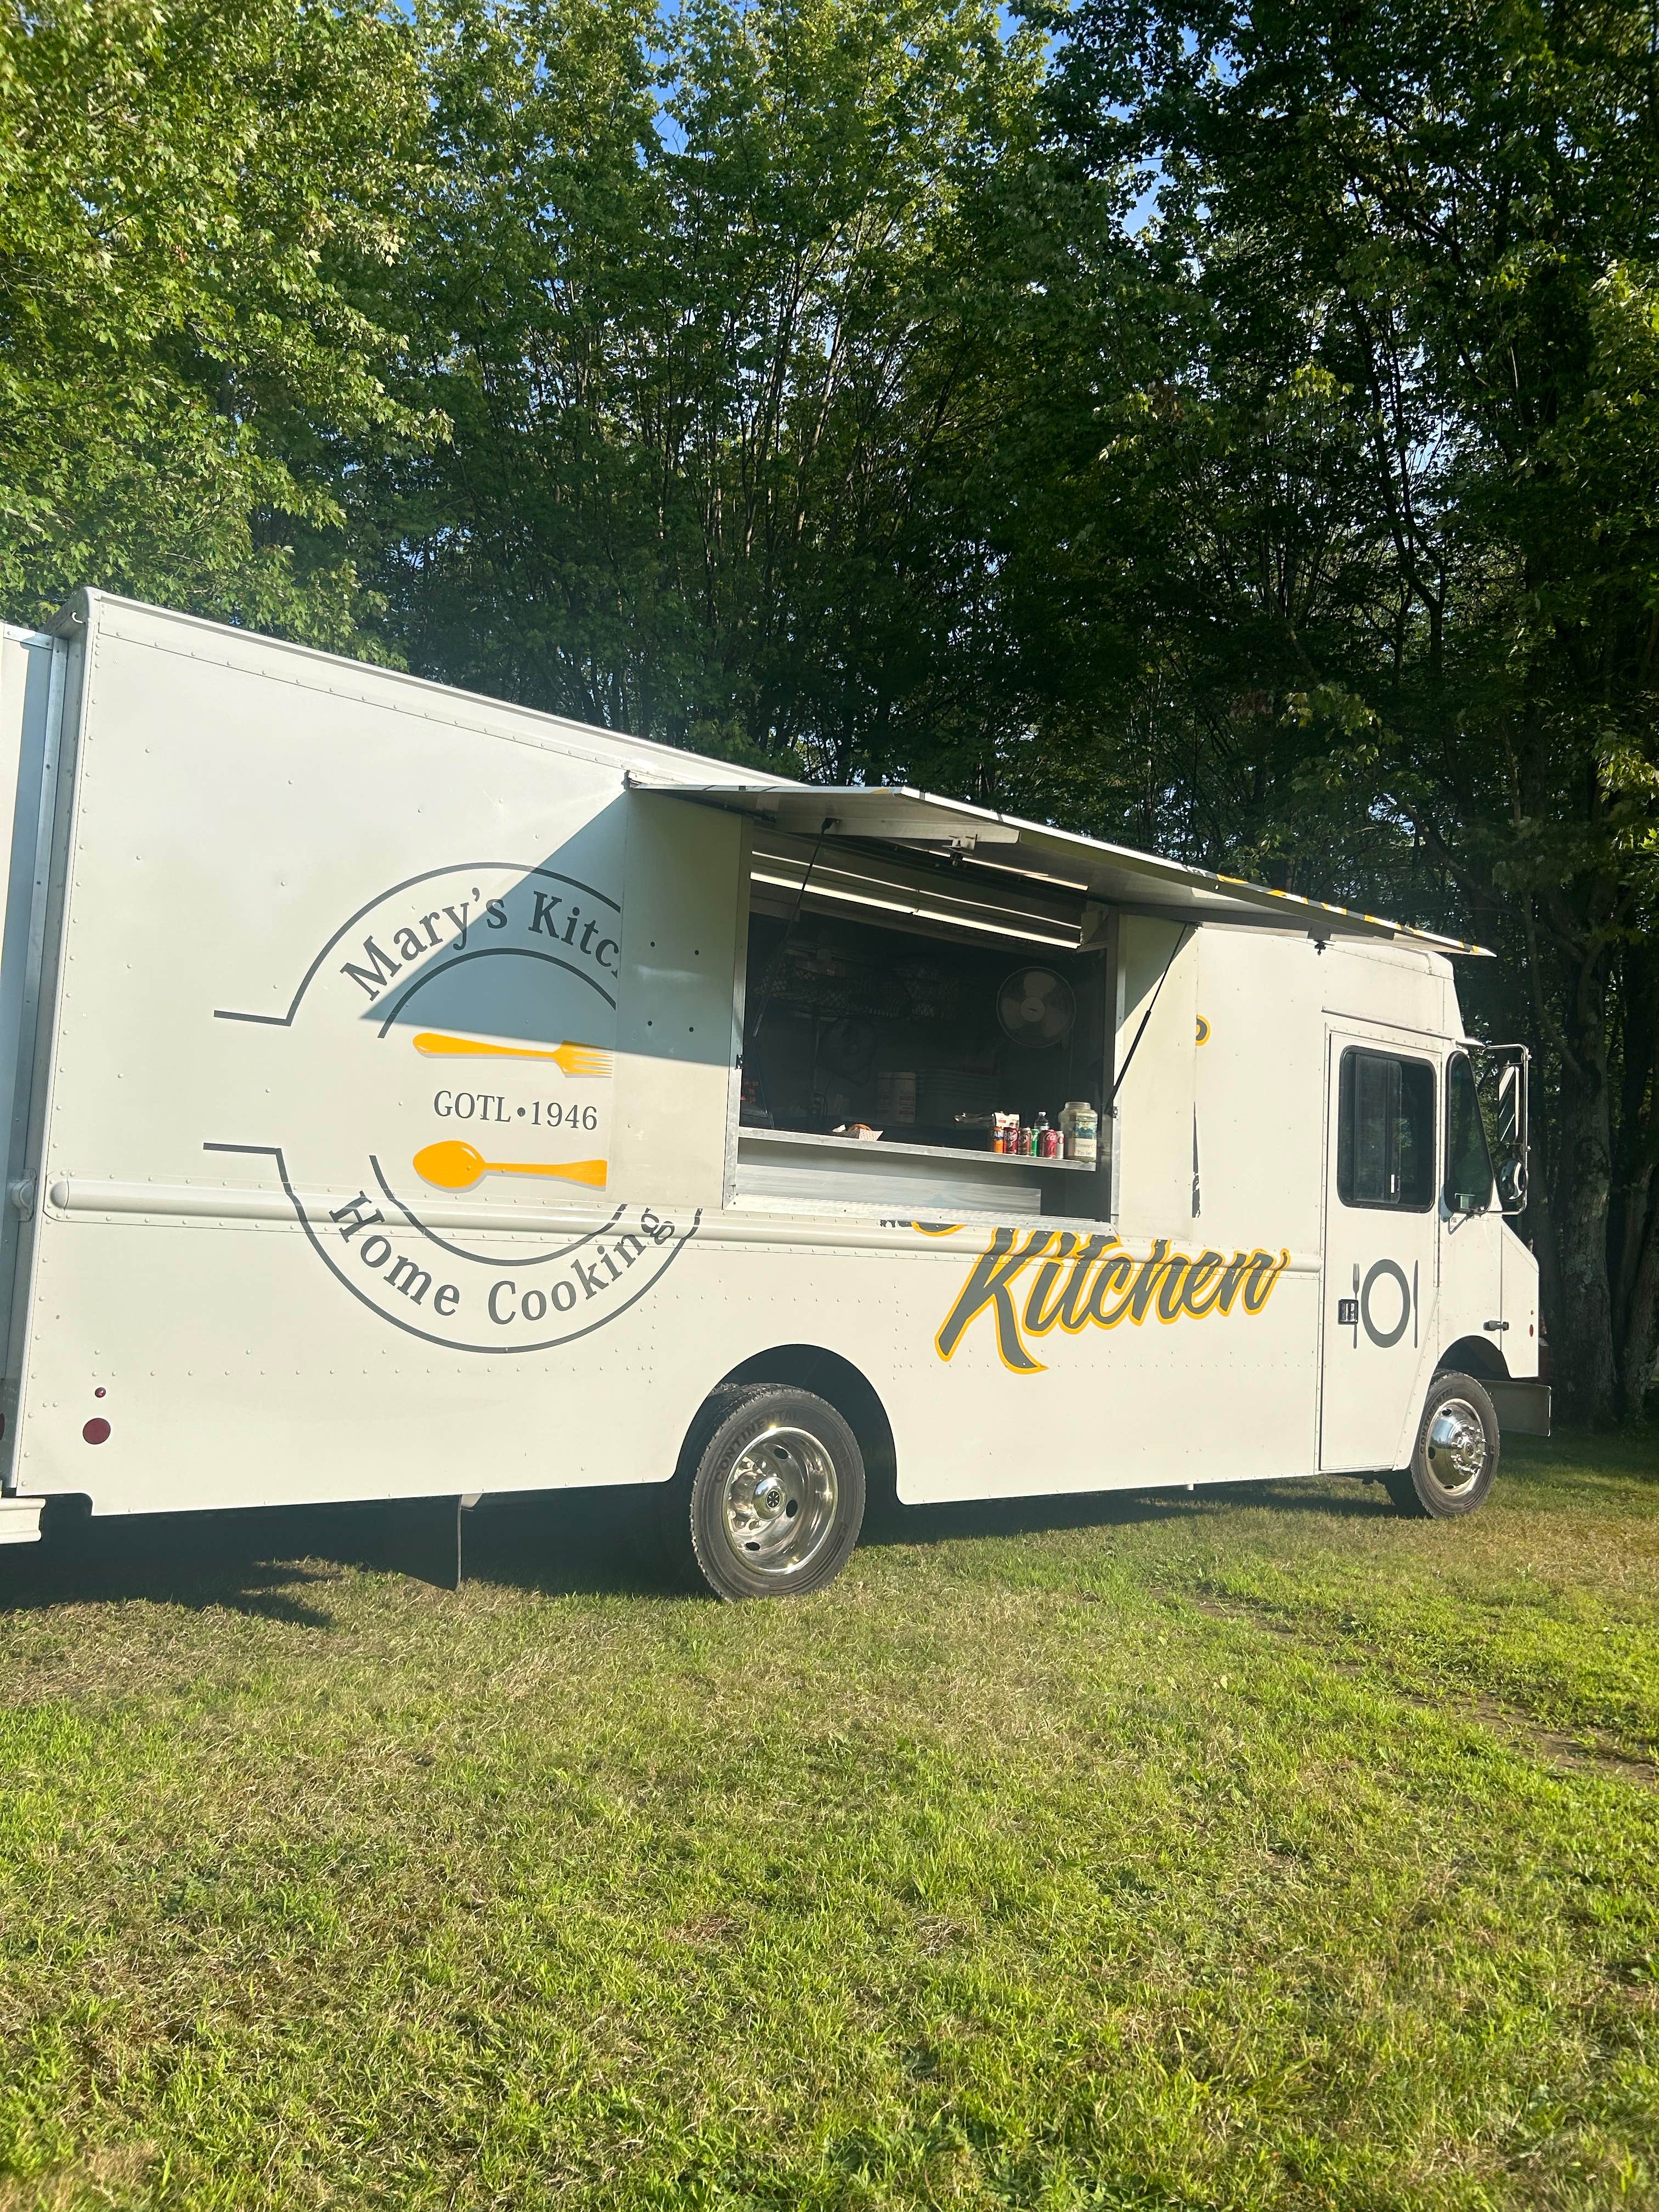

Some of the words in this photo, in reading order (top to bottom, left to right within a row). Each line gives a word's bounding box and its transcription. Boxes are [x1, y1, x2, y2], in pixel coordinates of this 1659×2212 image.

[339, 887, 507, 1002] Mary's
[528, 890, 620, 979] Kitc
[329, 1190, 460, 1317] Home
[488, 1207, 675, 1325] Cooking
[934, 1227, 1291, 1375] Kitchen
